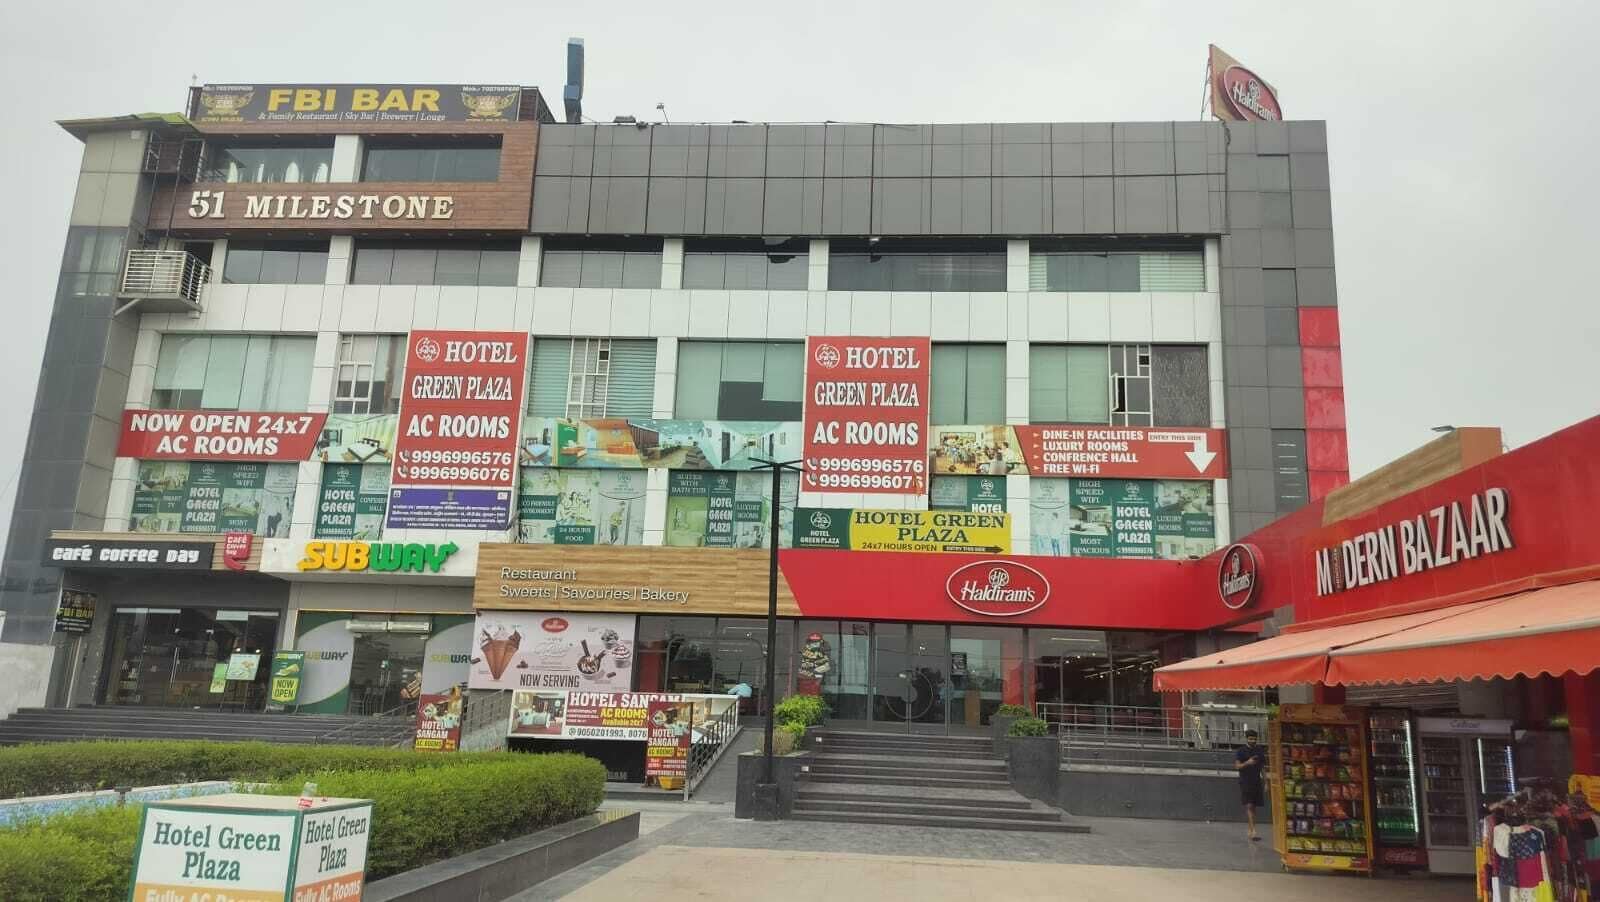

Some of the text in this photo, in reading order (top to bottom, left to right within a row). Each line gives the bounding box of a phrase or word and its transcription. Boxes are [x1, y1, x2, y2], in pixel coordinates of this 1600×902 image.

[267, 88, 440, 112] FBI BAR
[268, 112, 294, 123] Family
[296, 111, 338, 121] Restaurant
[187, 190, 454, 220] 51 MILESTONE
[444, 341, 517, 364] HOTEL
[845, 347, 920, 369] HOTEL
[411, 375, 512, 400] GREEN PLAZA
[814, 382, 919, 407] GREEN PLAZA
[131, 413, 312, 434] NOW OPEN 24x7
[406, 414, 510, 439] AC ROOMS
[813, 421, 919, 446] AC ROOMS
[1043, 430, 1144, 441] DINE-IN FACILITIES
[156, 436, 278, 456] AC ROOMS
[1043, 441, 1128, 452] LUXURY ROOMS
[411, 450, 512, 465] 9996996576
[820, 457, 924, 473] 9996996576
[1043, 452, 1138, 463] CONFRENCE HALL
[410, 466, 510, 481] 9996996076
[1043, 463, 1100, 474] FREE WI-FI
[190, 487, 220, 498] HOTEL
[324, 489, 356, 500] HOTEL
[186, 499, 220, 510] GREEN
[321, 501, 355, 513] GREEN
[710, 496, 733, 508] HOTEL
[971, 503, 1004, 513] HOTEL
[185, 511, 216, 523] PLAZA
[321, 514, 351, 525] PLAZA
[709, 510, 733, 520] GREEN
[1116, 506, 1152, 518] HOTEL
[709, 522, 731, 533] PLAZA
[855, 511, 1005, 529] HOTEL GREEN
[1115, 519, 1153, 531] GREEN
[897, 527, 969, 543] PLAZA
[1118, 532, 1152, 544] PLAZA
[1400, 487, 1512, 575] BAZAAR
[884, 543, 912, 551] HOURS
[915, 543, 938, 551] OPEN
[296, 540, 460, 573] SUBWAY
[500, 566, 577, 581] Restaurant
[500, 584, 689, 604] Sweets Savouries Bakery
[961, 580, 1035, 603] Haldiram's
[276, 679, 294, 689] NOW
[520, 673, 541, 687] NOW
[543, 674, 580, 688] SERVING
[275, 689, 294, 698] OPEN
[570, 692, 617, 707] HOTEL
[600, 708, 614, 718] AC
[615, 708, 648, 719] ROOMS
[422, 720, 446, 730] HOTEL
[417, 729, 448, 739] SANGAM
[652, 728, 675, 738] HOTEL
[648, 737, 679, 747] SANGAM
[152, 821, 281, 852] Hotel Green
[304, 815, 367, 845] Hotel Green
[181, 850, 241, 881] Plaza
[318, 845, 347, 874] Plaza
[319, 885, 332, 901] AC
[333, 879, 361, 900] Rooms
